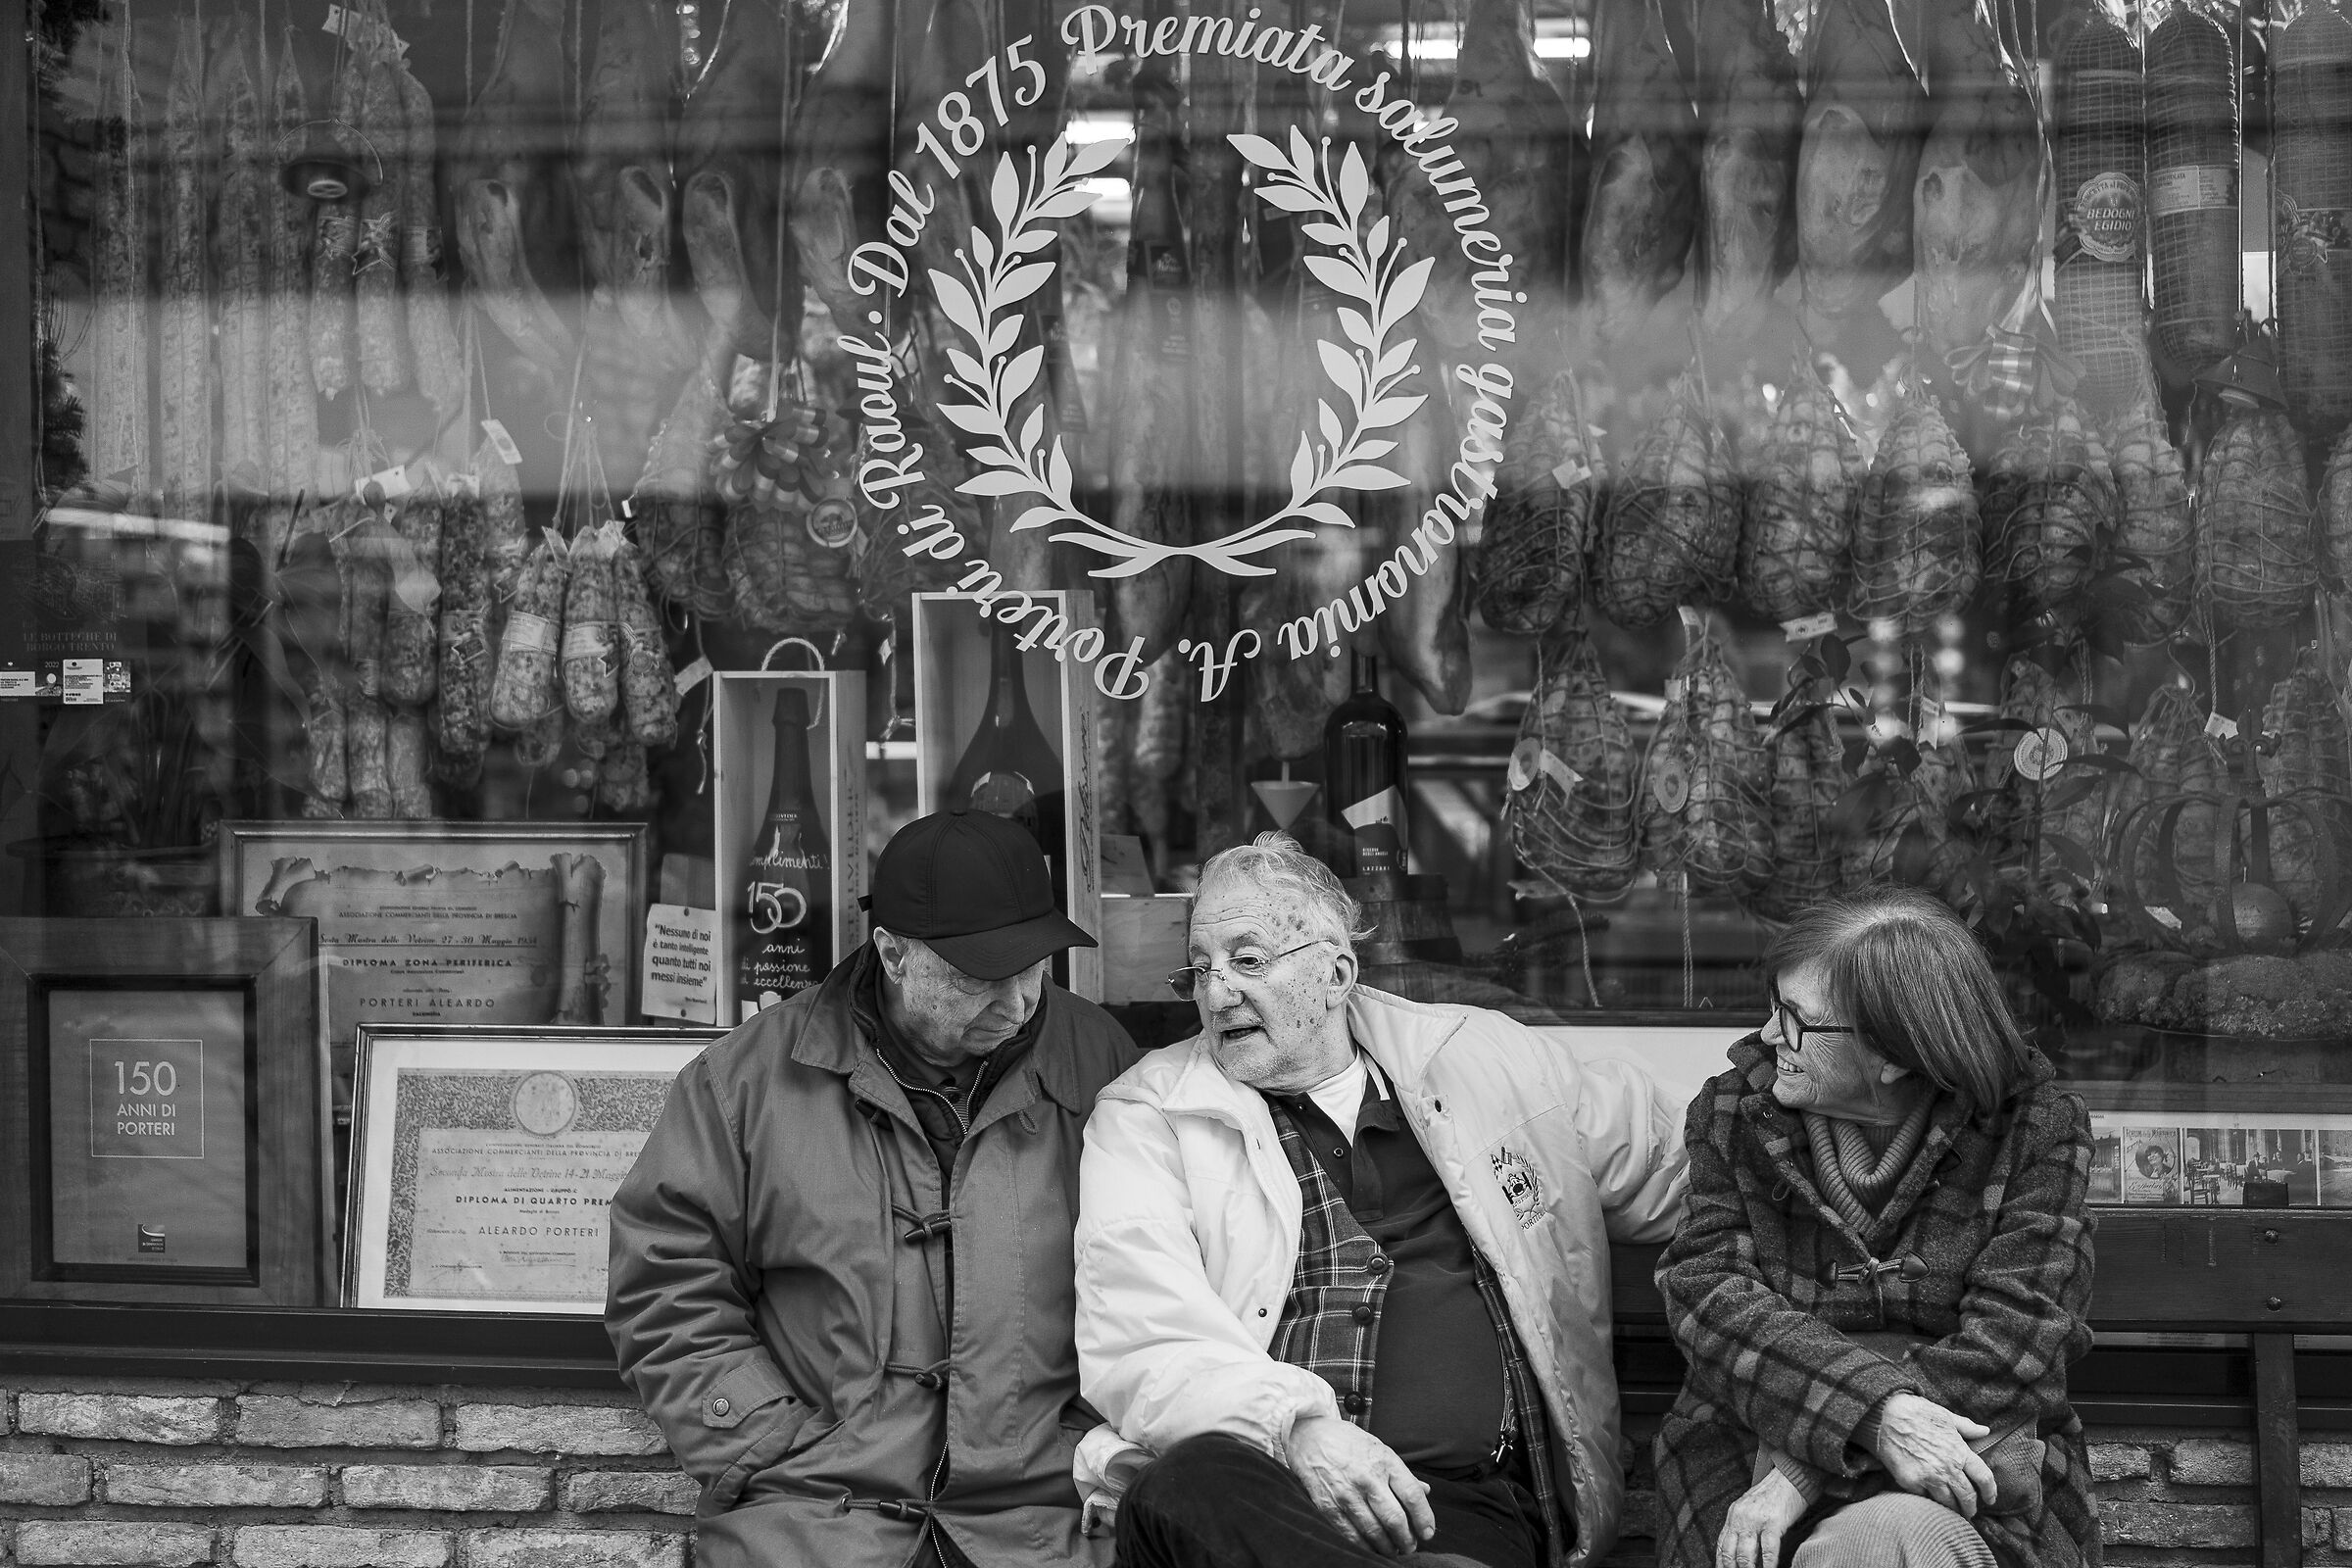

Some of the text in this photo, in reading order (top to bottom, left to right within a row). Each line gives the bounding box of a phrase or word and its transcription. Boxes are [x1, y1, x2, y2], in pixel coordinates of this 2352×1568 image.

[1061, 5, 1354, 90] Premiata
[915, 34, 1045, 178] 1875
[1355, 73, 1527, 351] salumeria
[2086, 208, 2134, 220] BEDOGNI
[2094, 220, 2132, 231] EGIDIO
[848, 171, 934, 298] Dal
[1278, 364, 1513, 660] gastronomia
[898, 505, 964, 559] di
[946, 559, 1149, 699] Porteri
[748, 881, 807, 934] 150
[692, 928, 698, 940] di
[700, 930, 710, 941] noi
[660, 941, 678, 951] tanto
[762, 938, 806, 954] anni
[652, 956, 710, 971] quanto tutti noi
[651, 972, 675, 983] messi
[361, 998, 495, 1007] PORTERI ALEARDO
[115, 1061, 176, 1096] 150
[118, 1103, 175, 1117] ANNI DI
[118, 1122, 174, 1136] PORTERI
[531, 1197, 576, 1205] QUARTO
[478, 1226, 599, 1237] ALEARDO PORTERI
